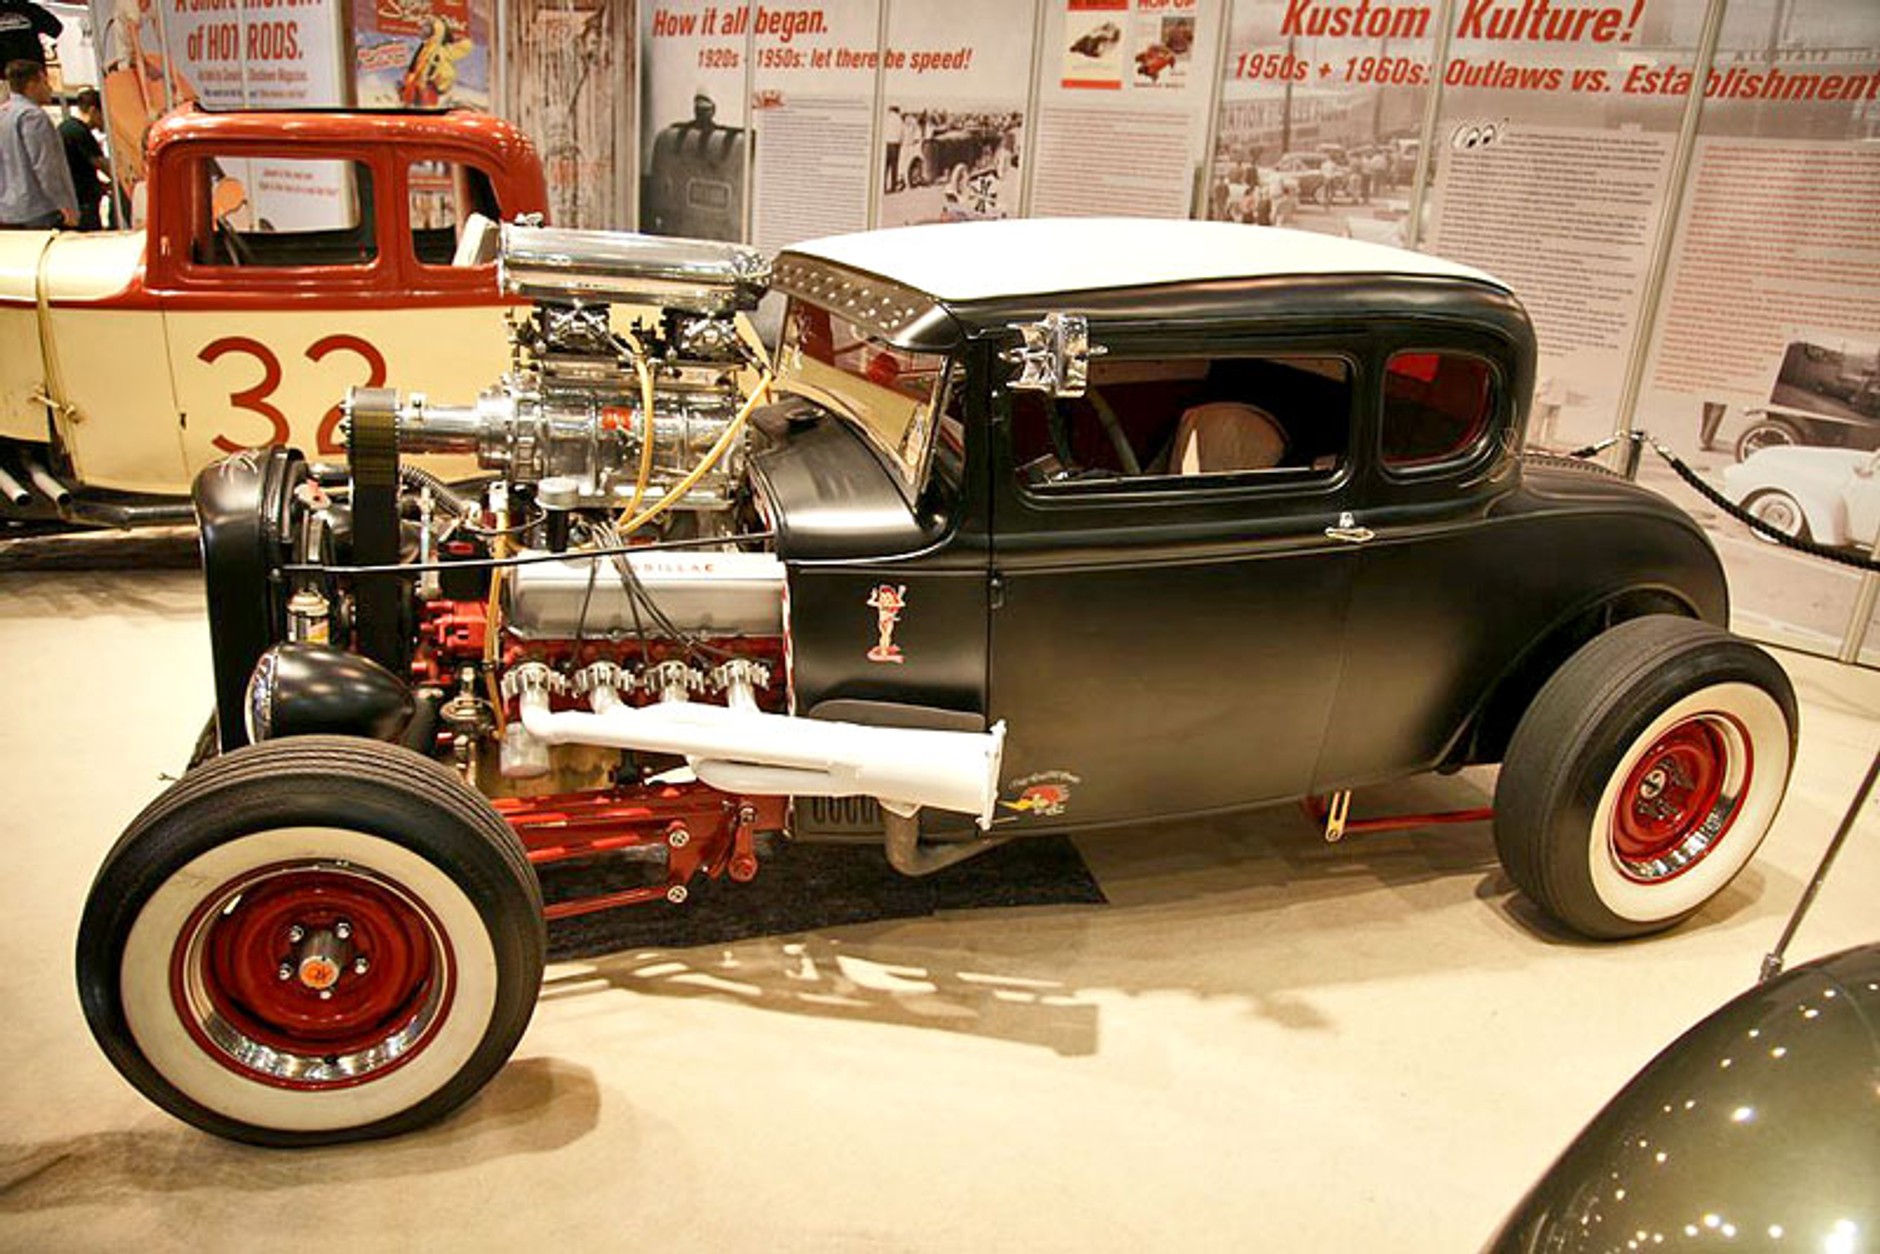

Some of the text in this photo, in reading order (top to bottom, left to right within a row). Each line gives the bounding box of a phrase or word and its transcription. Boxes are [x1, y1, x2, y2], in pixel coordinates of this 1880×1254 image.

[653, 6, 828, 42] How it all began.
[1280, 0, 1645, 42] Kustom Kulture!
[187, 21, 303, 61] of HOT RODS.
[698, 50, 739, 67] 1920s
[757, 49, 805, 68] 1950s:
[810, 48, 833, 67] let
[836, 48, 879, 68] there
[884, 48, 905, 68] be
[909, 48, 973, 73] speed!
[1236, 53, 1309, 80] 1950s
[1319, 63, 1331, 76] +
[1344, 57, 1432, 84] 1960s:
[1444, 59, 1564, 90] Outlaws
[1571, 69, 1611, 92] vs.
[197, 334, 392, 456] 32
